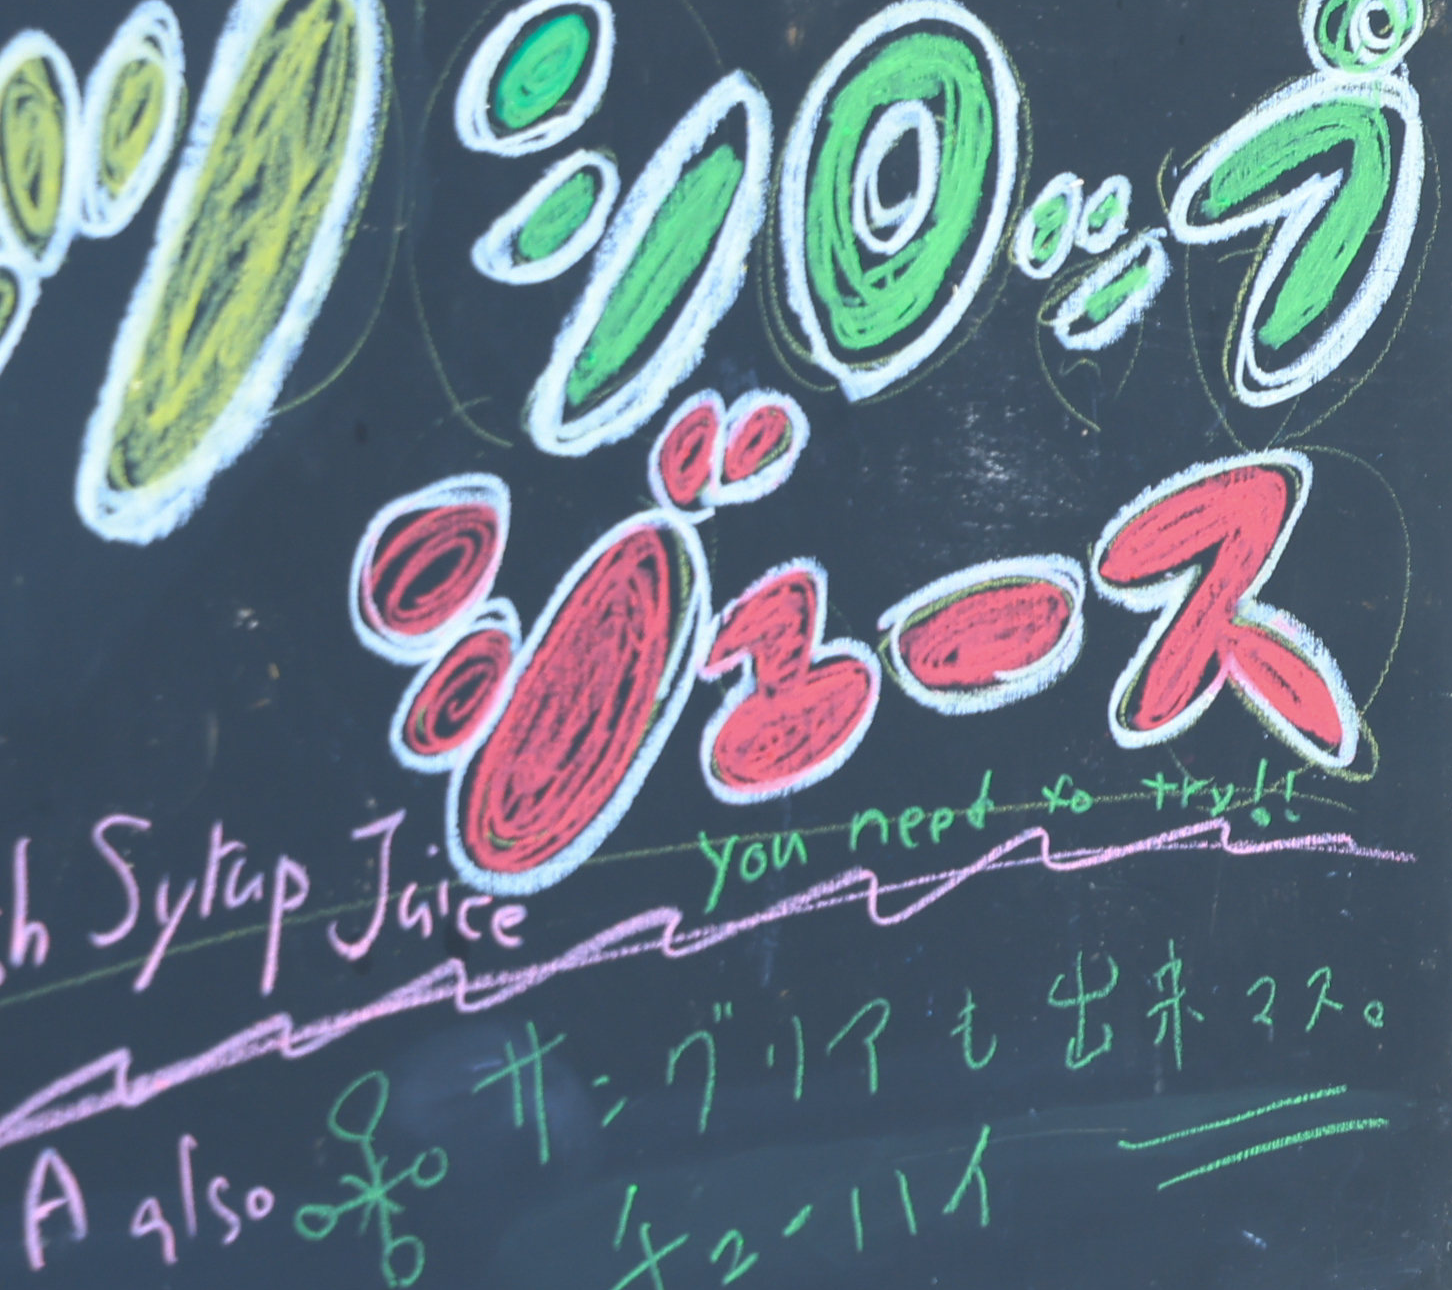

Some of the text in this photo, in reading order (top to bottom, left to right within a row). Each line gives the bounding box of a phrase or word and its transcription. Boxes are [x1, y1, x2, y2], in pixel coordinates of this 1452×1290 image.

[349, 389, 1362, 897] ジュース
[1041, 774, 1094, 814] to
[328, 807, 527, 961] Juice
[130, 1132, 276, 1266] also
